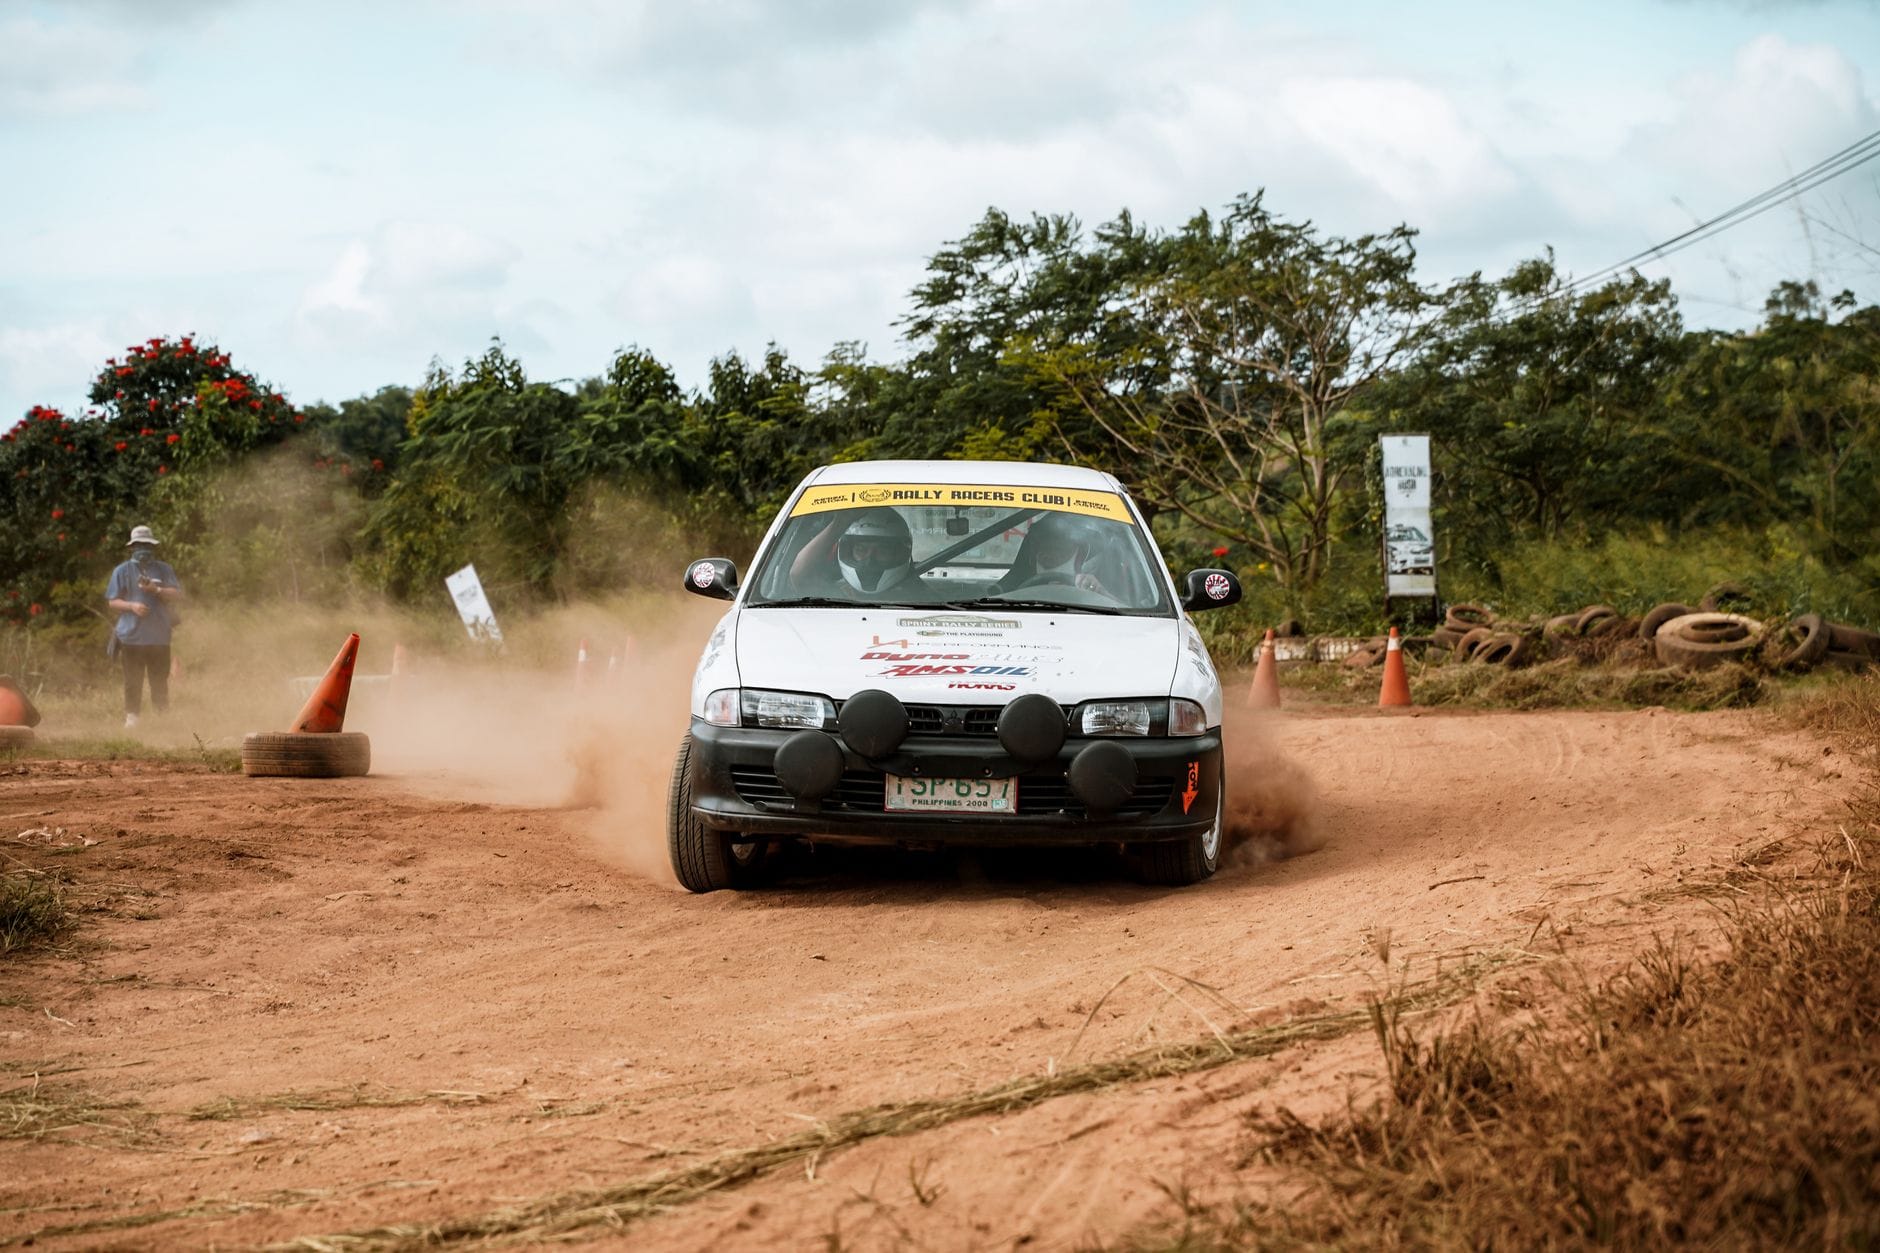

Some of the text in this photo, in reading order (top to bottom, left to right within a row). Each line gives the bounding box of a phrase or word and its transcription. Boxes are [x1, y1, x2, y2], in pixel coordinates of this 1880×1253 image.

[892, 489, 943, 500] RALLY
[951, 490, 1015, 502] RACERS
[1022, 492, 1065, 505] CLUB
[901, 619, 1017, 630] SPRINT RALLY SERIES
[878, 664, 1033, 677] AMSOIL
[912, 798, 963, 807] PHILIPPINES
